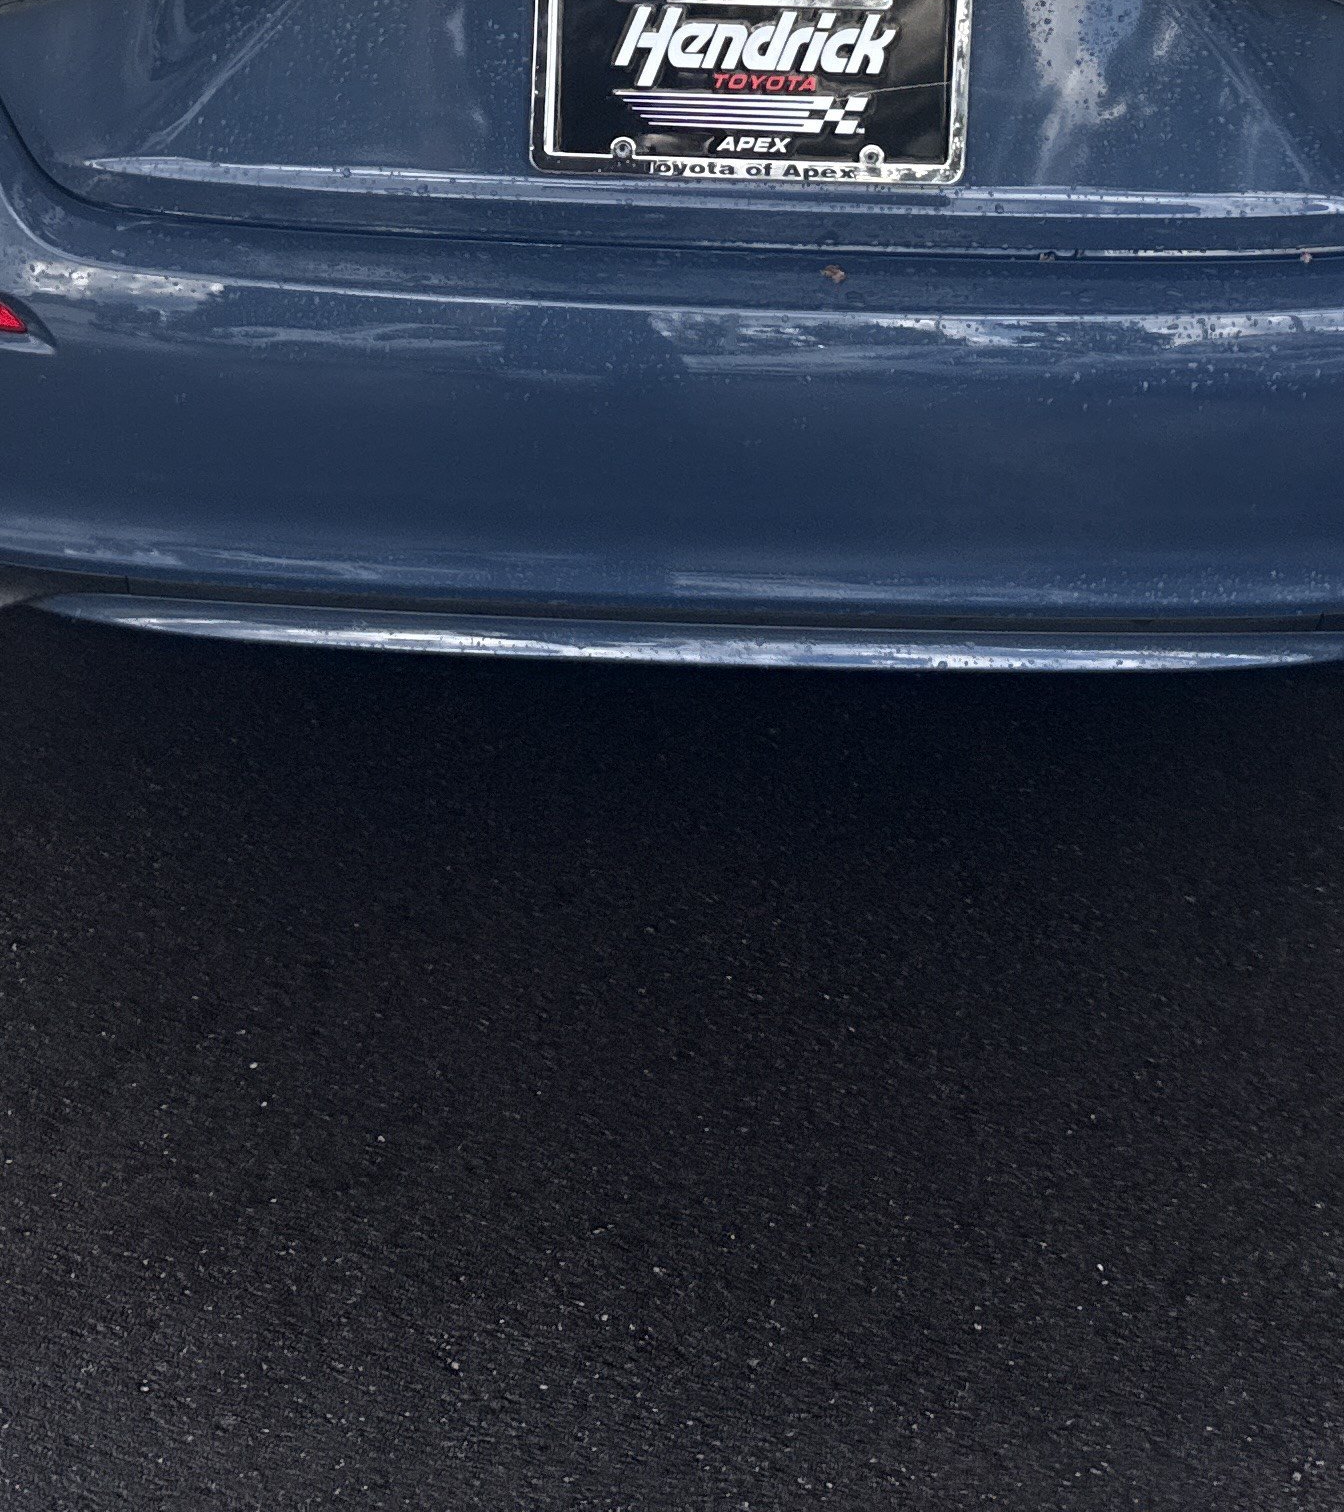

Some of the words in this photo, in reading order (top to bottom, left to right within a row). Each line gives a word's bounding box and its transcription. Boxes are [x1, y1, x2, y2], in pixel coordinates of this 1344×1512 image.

[614, 5, 896, 87] Hendrick
[713, 73, 817, 92] TOYOTA
[716, 136, 791, 153] APEX
[745, 163, 773, 177] of
[782, 164, 857, 181] Apex
